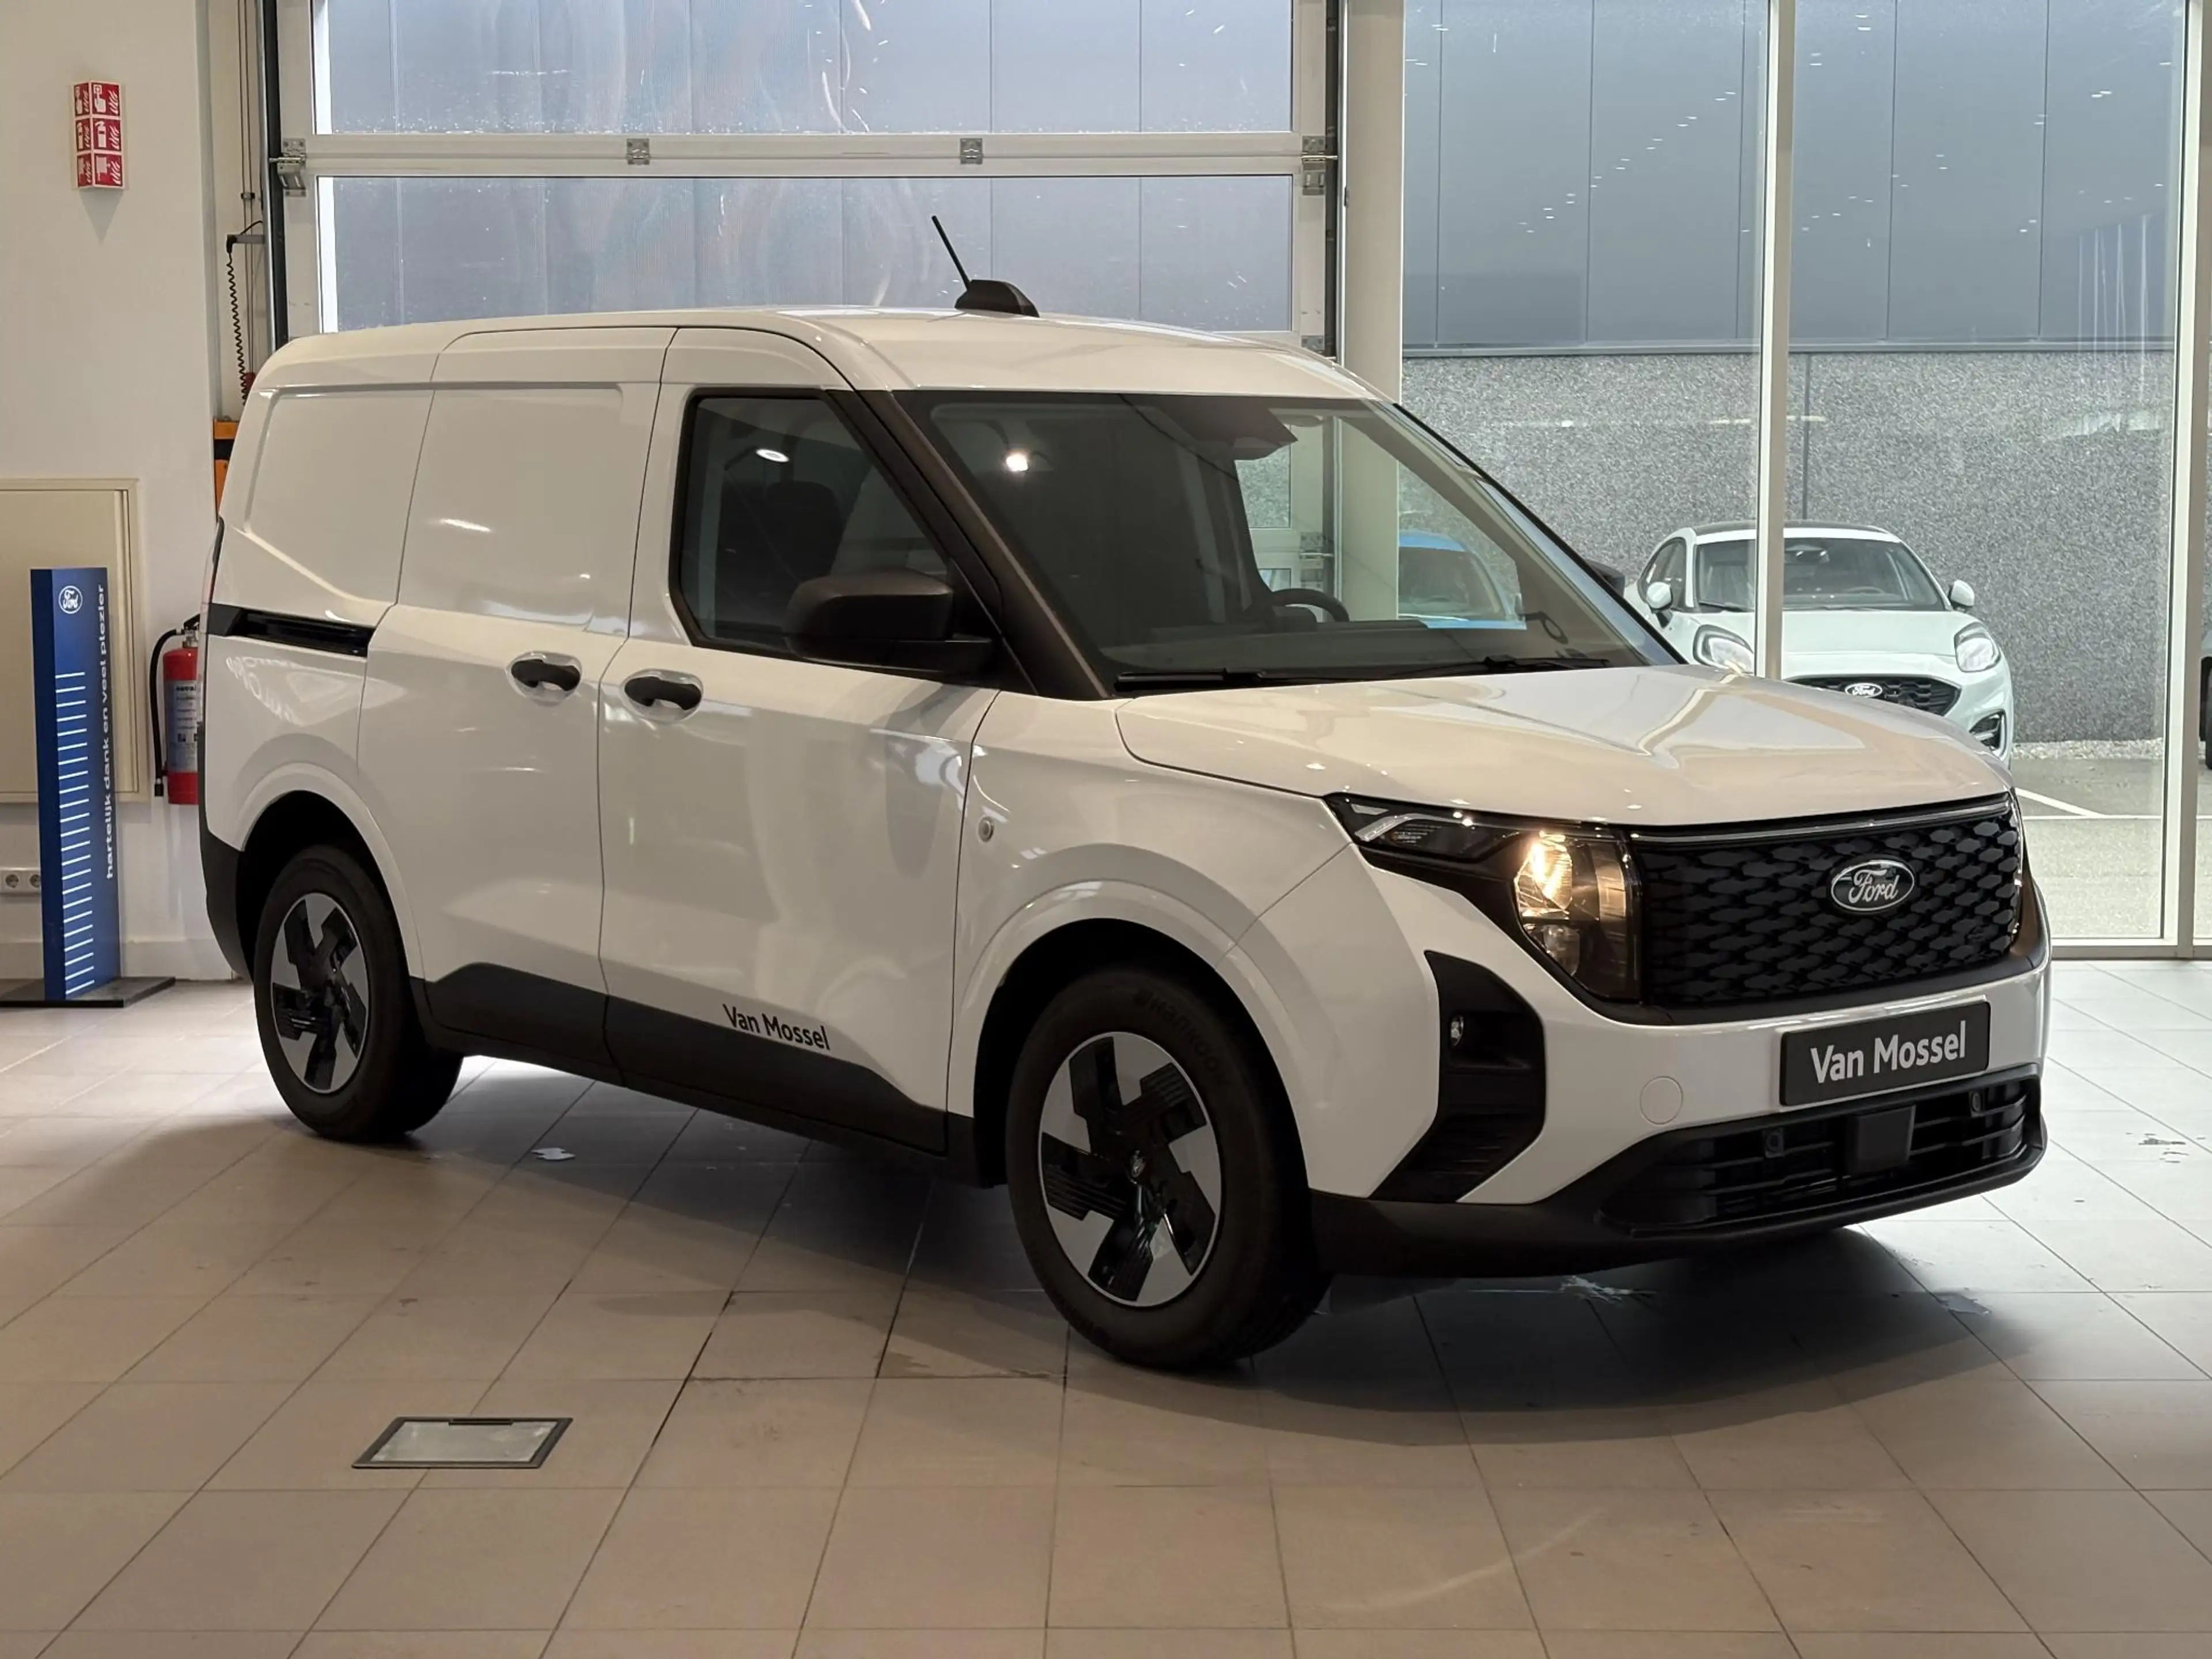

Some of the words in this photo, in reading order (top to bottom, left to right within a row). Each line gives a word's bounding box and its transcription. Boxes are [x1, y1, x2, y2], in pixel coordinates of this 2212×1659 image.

[98, 584, 107, 655] plezier
[100, 660, 108, 703] veel
[103, 707, 109, 733] en
[105, 793, 113, 880] hartelijk
[1849, 869, 1900, 904] Ford
[722, 1003, 761, 1033] Van
[762, 1013, 831, 1051] Mossel
[1810, 1045, 1864, 1084] Van
[1873, 1020, 1966, 1074] Mossel
